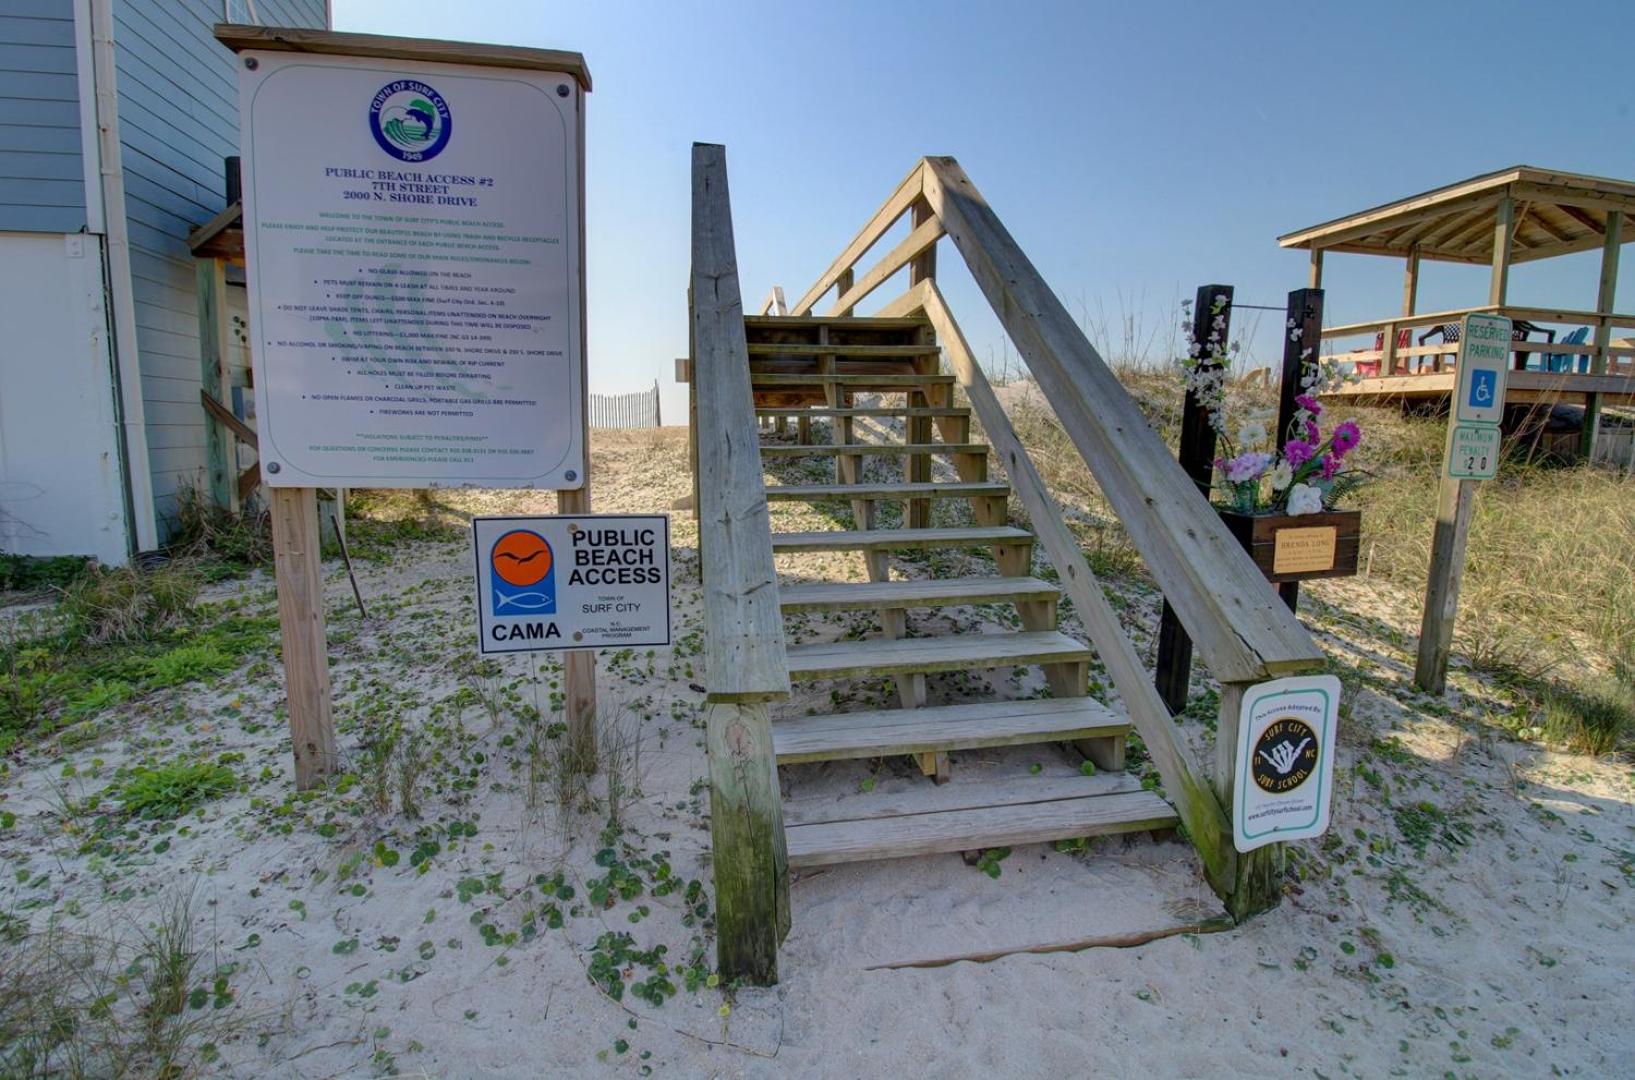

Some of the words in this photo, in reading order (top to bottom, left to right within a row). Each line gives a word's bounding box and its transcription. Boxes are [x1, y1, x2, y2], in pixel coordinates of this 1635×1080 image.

[372, 86, 393, 113] TOWN
[393, 82, 407, 92] OF
[408, 82, 434, 97] SURF
[433, 97, 449, 119] CITY
[325, 167, 374, 180] PUBLIC
[378, 170, 422, 183] BEACH
[426, 173, 475, 186] ACCESS
[478, 177, 494, 187] #2
[372, 181, 396, 192] 7TH
[400, 183, 450, 195] STREET
[343, 190, 370, 201] 2000
[373, 192, 386, 202] N.
[390, 193, 434, 205] SHORE
[438, 196, 478, 207] DRIVE
[1468, 324, 1508, 342] RESERVED
[1470, 344, 1504, 360] PARKING
[572, 529, 655, 547] PUBLIC
[575, 548, 654, 566] BEACH
[568, 568, 661, 586] ACCESS
[582, 604, 612, 614] SURF
[616, 603, 640, 612] CITY
[492, 622, 561, 642] CAMA
[1265, 723, 1284, 740] SURF
[1288, 723, 1308, 736] CITY
[1306, 749, 1316, 760] NC
[1258, 774, 1275, 788] SURF
[1278, 768, 1308, 789] SCHOOL
